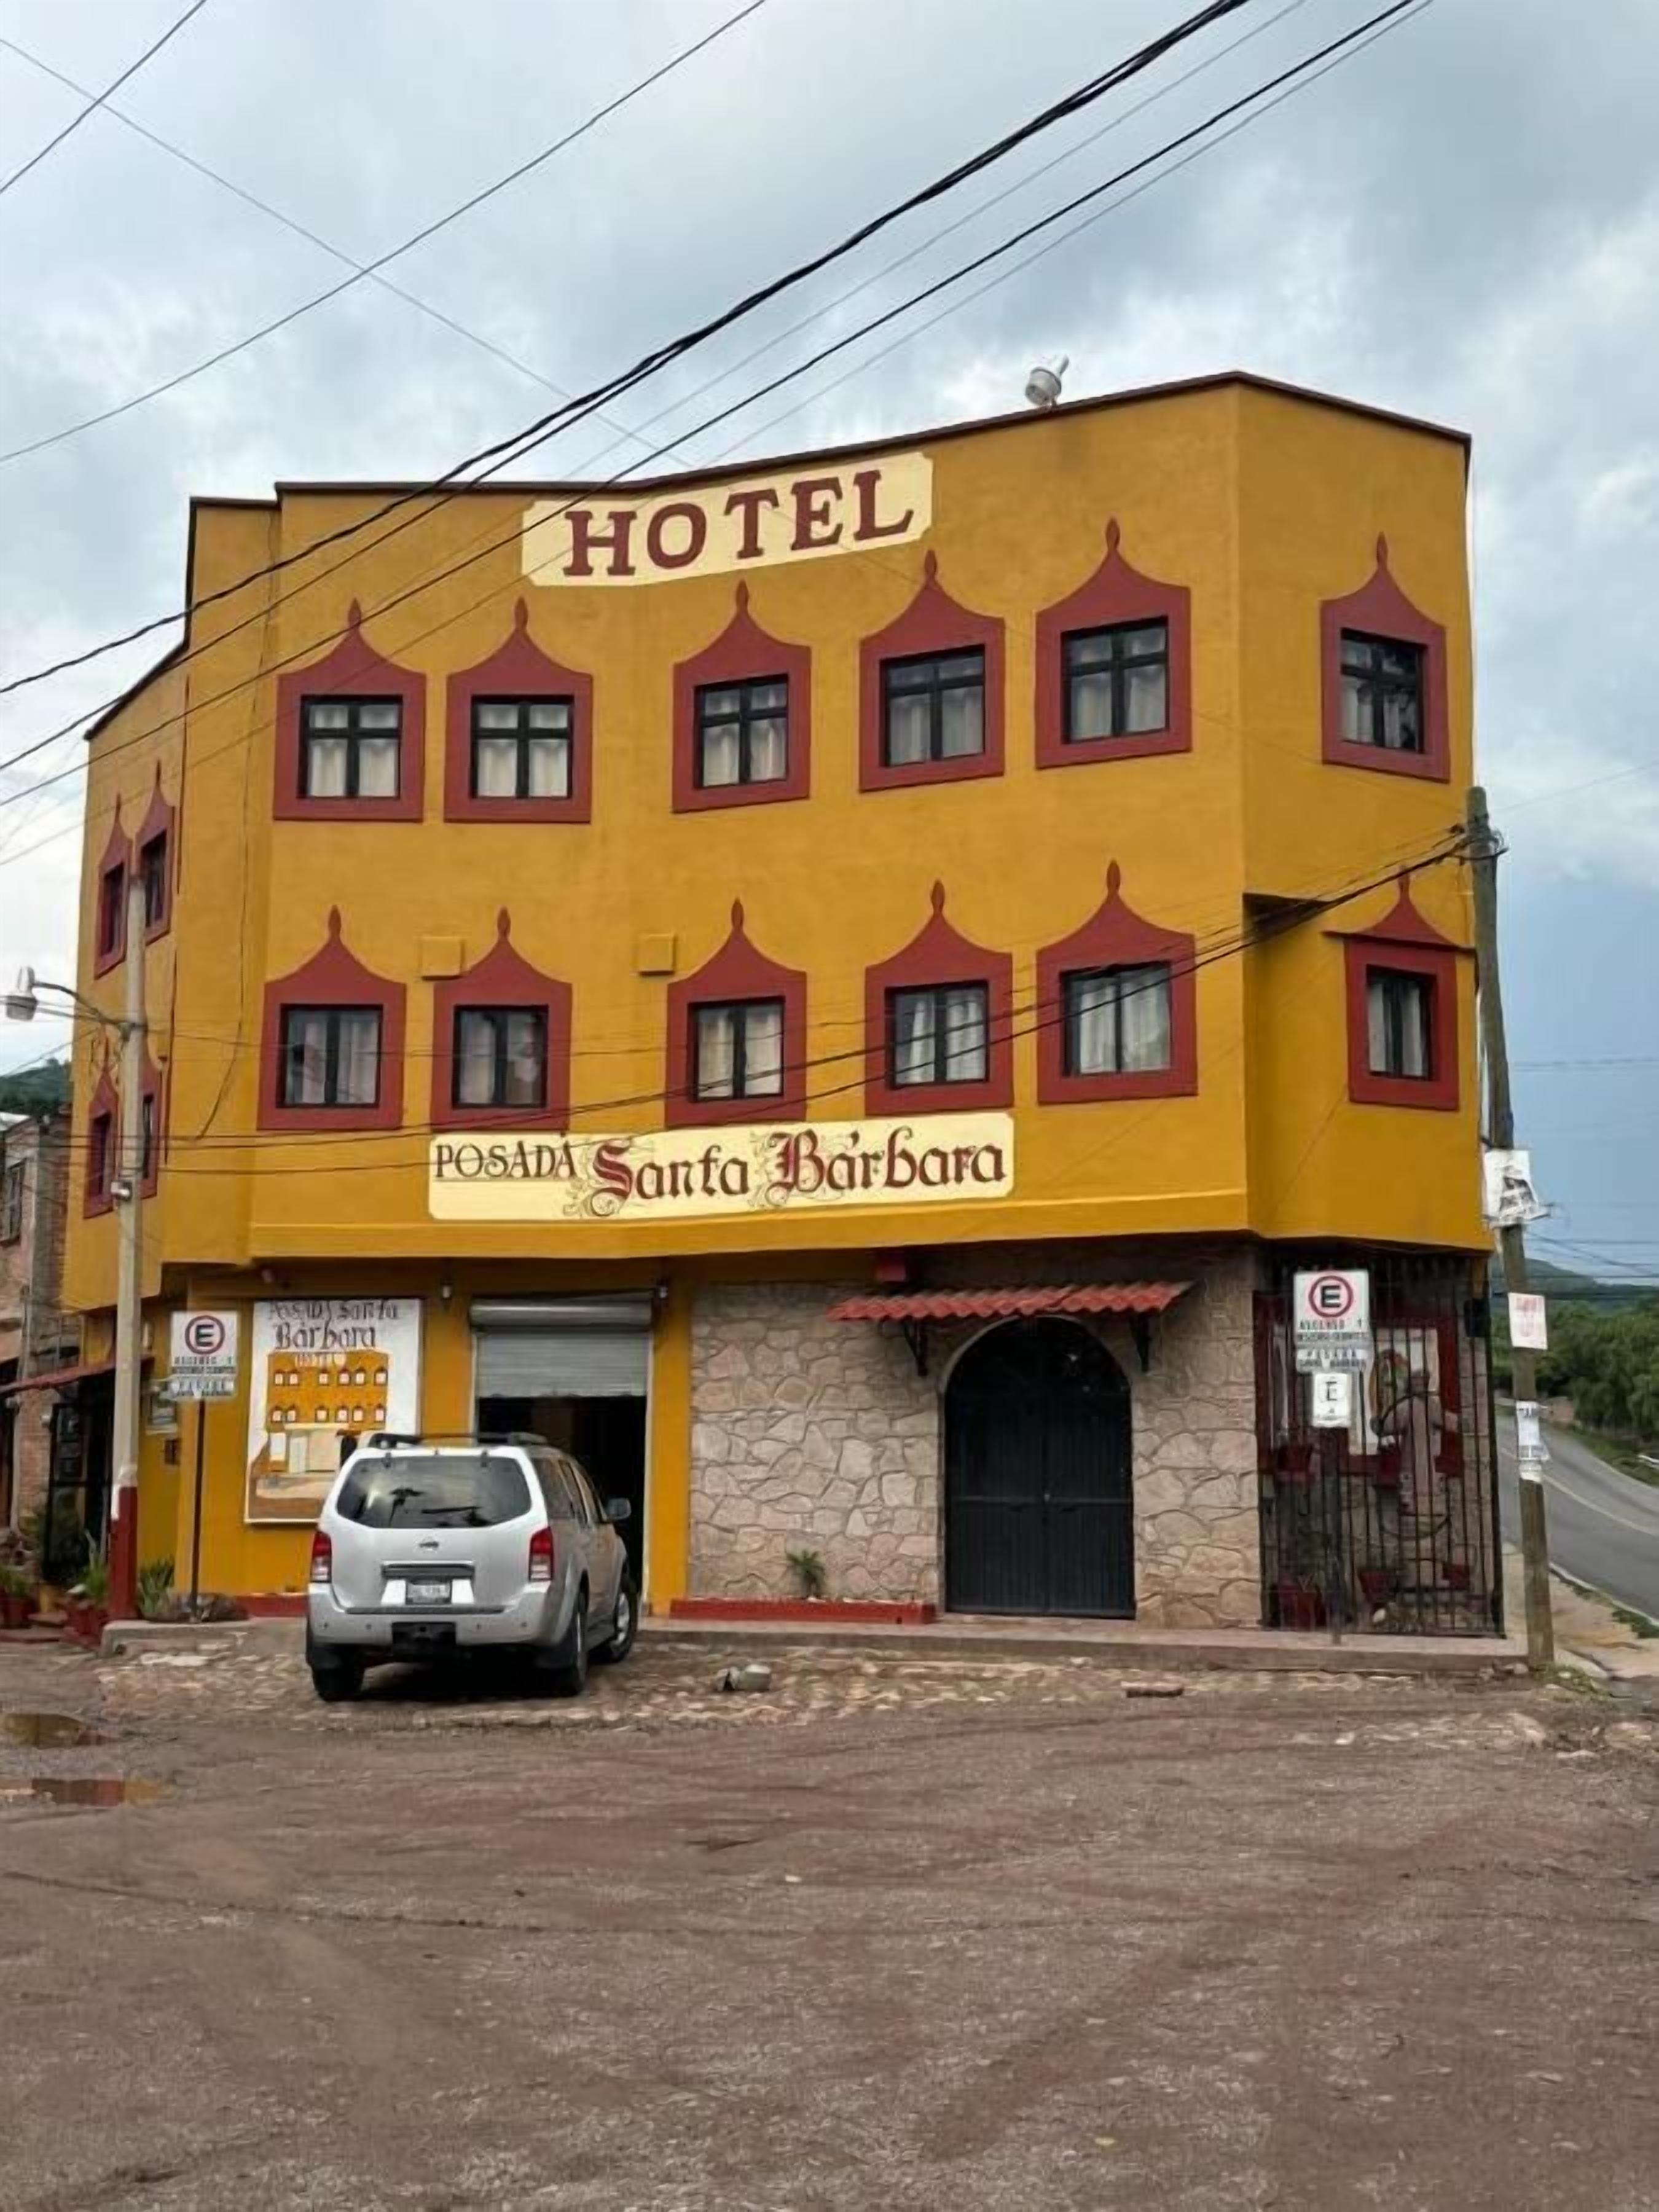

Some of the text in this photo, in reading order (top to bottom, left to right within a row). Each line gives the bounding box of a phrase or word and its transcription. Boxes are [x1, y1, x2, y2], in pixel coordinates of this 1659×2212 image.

[563, 469, 914, 576] HOTEL
[436, 1126, 1006, 1216] POSADA Santa Bárbara
[1321, 1285, 1341, 1308] E
[196, 1324, 214, 1346] E
